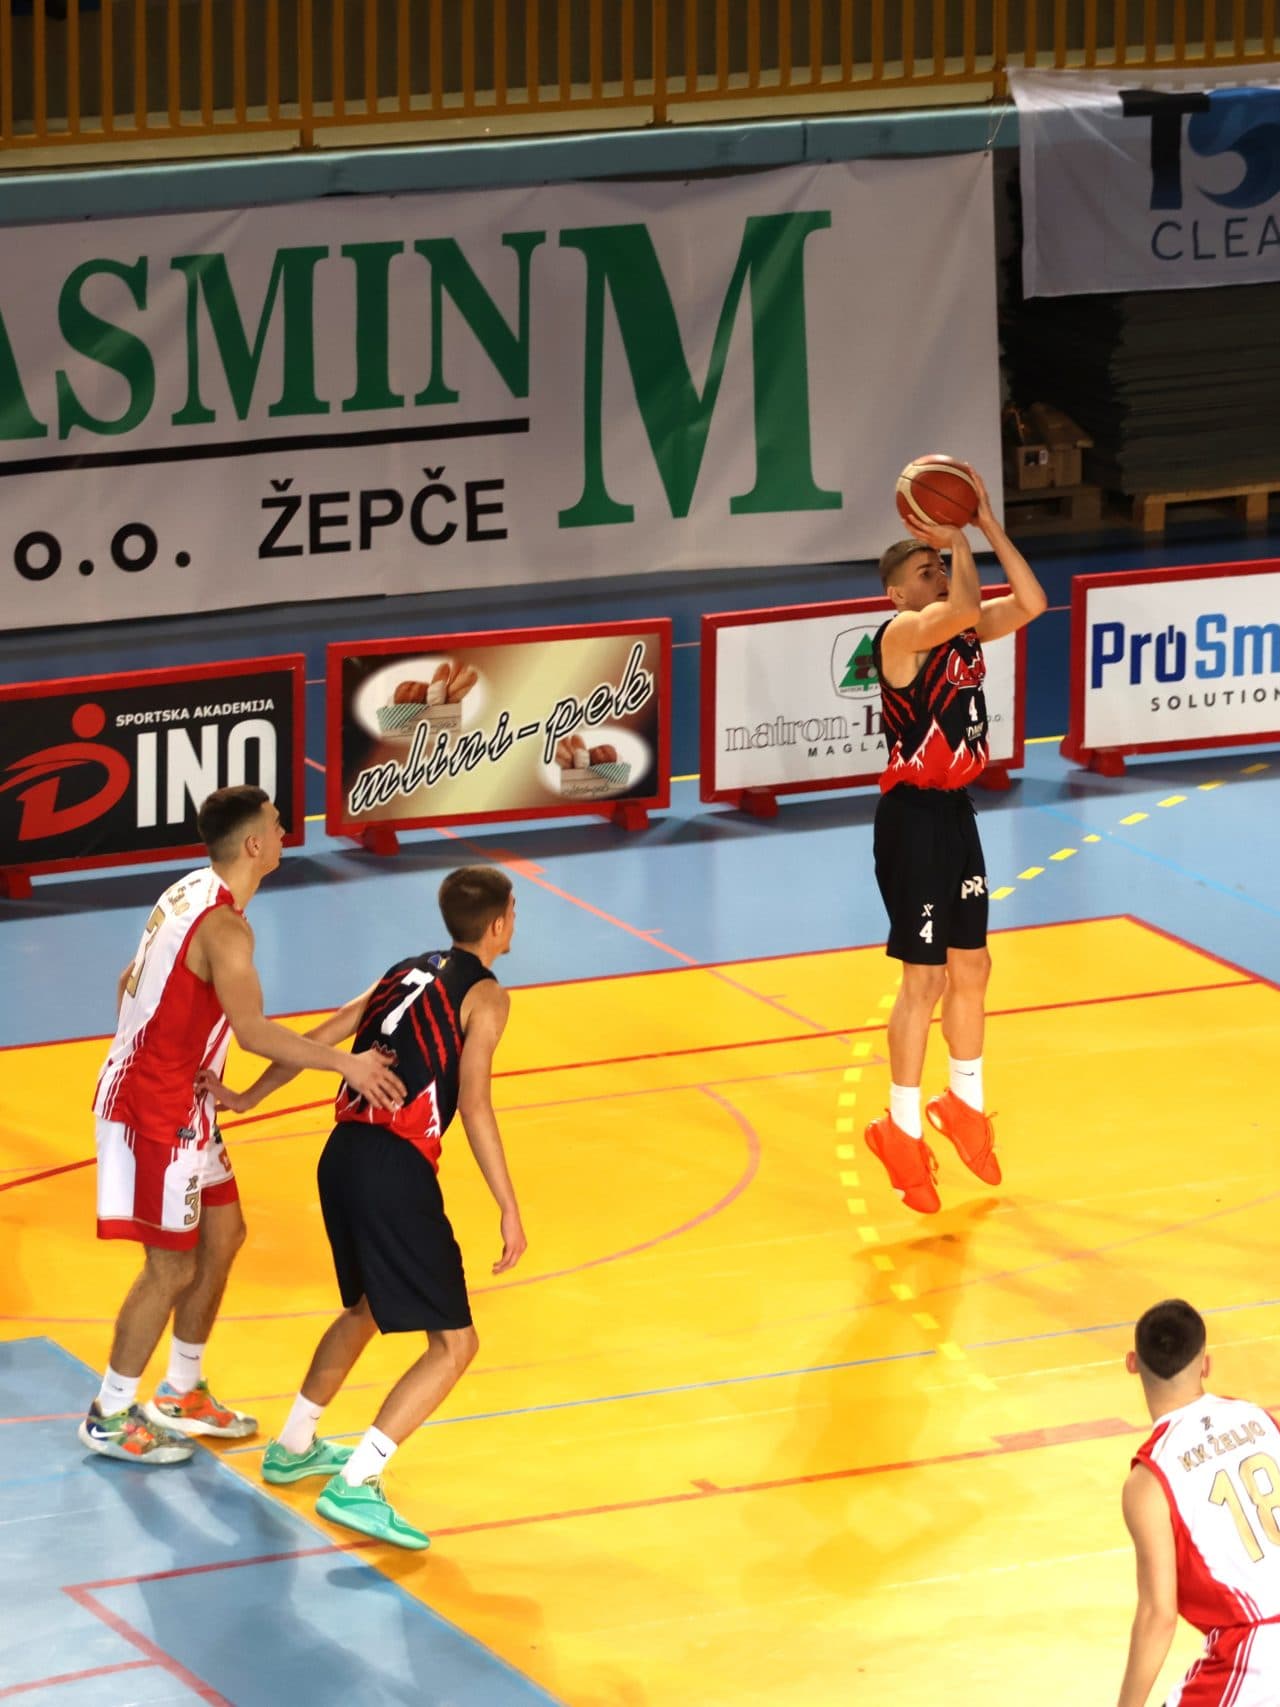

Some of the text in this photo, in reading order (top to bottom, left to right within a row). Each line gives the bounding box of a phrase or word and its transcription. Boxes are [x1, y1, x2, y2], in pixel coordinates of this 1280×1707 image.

[558, 210, 842, 528] M
[258, 466, 508, 558] ŽEPČE
[116, 698, 275, 727] SPORTSKA AKADEMIJA
[725, 705, 885, 752] natron-h
[808, 737, 885, 757] MAGLA
[919, 920, 934, 944] 4
[380, 968, 435, 1036] 7
[184, 1192, 200, 1226] 3
[1177, 1420, 1266, 1472] KK ŽELJO
